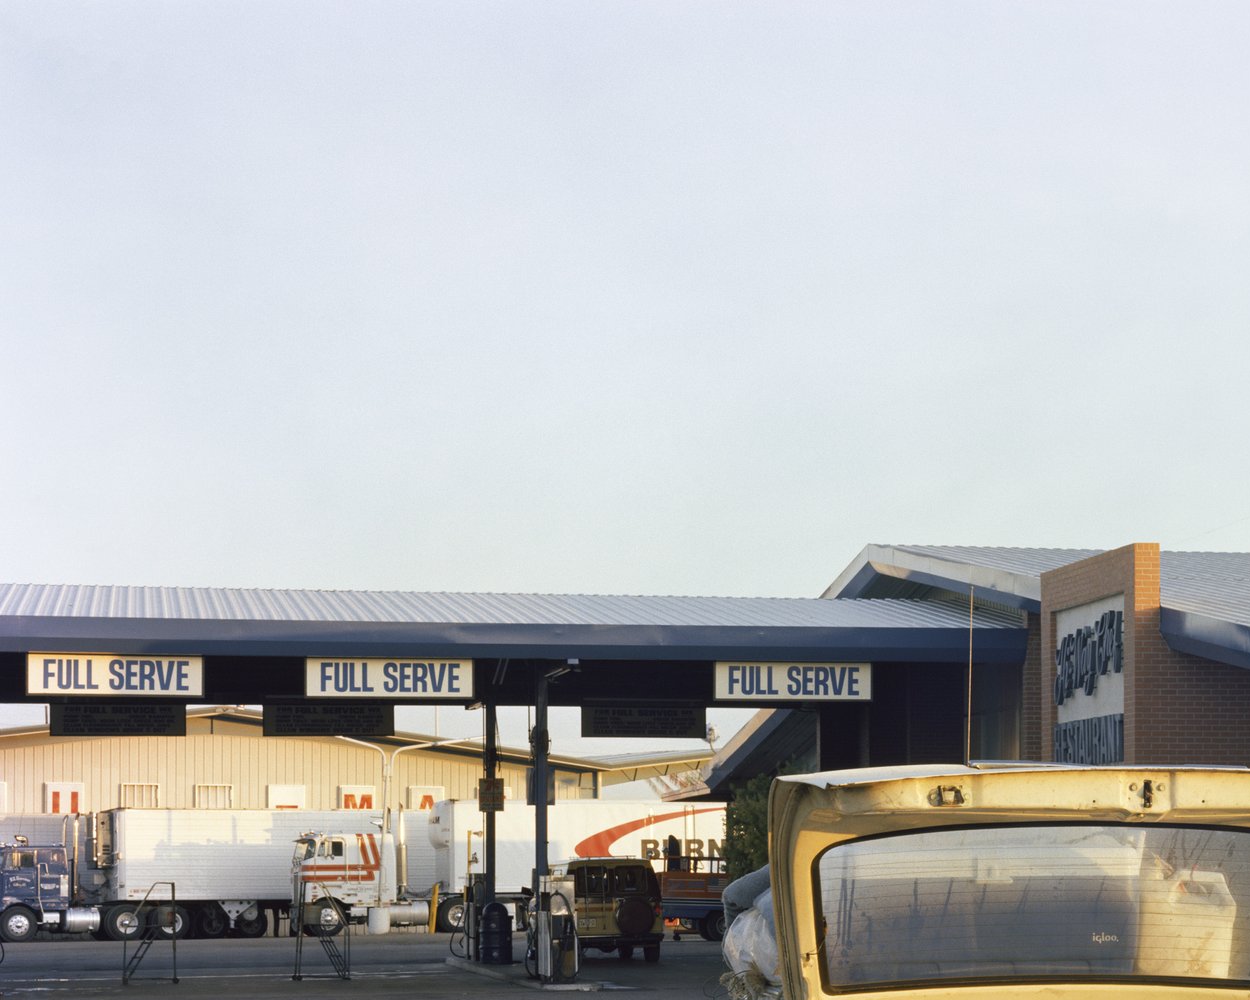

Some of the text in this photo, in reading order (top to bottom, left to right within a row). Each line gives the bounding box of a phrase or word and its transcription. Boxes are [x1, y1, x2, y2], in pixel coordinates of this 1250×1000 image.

[43, 659, 190, 691] FULL SERVE
[320, 662, 461, 693] FULL SERVE
[728, 665, 860, 696] FULL SERVE
[83, 706, 107, 714] FULL
[112, 706, 156, 714] SERVICE
[638, 709, 680, 717] SERVICE
[1054, 713, 1124, 766] RESTAURANT
